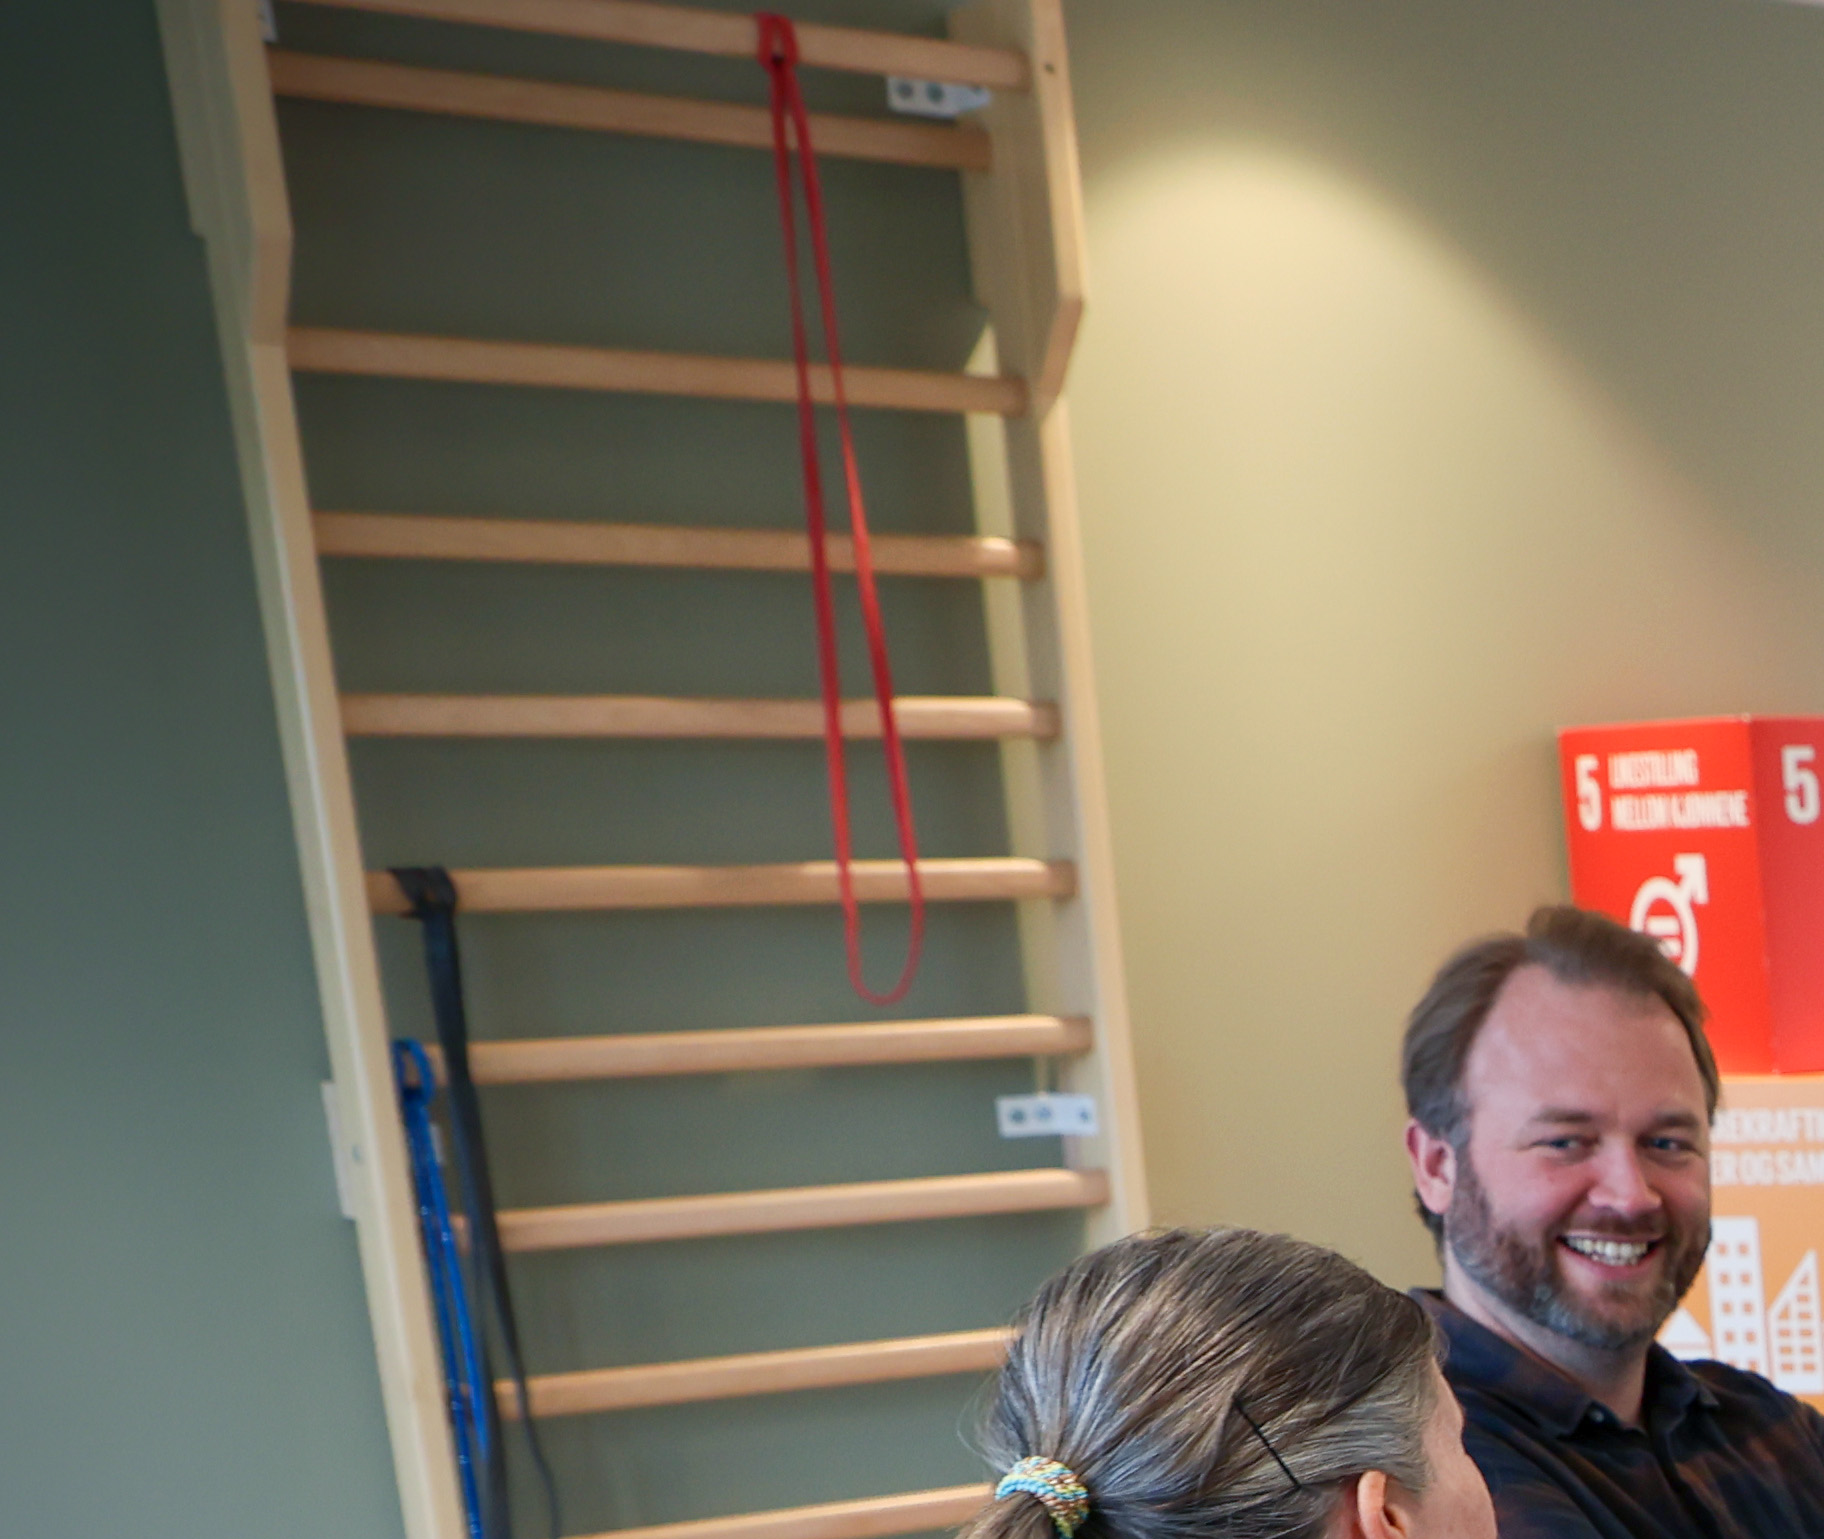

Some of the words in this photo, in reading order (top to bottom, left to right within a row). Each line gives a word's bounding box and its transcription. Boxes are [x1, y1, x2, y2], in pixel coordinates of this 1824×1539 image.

[1575, 754, 1602, 832] 5
[1781, 744, 1820, 825] 5
[1739, 1149, 1773, 1186] OG
